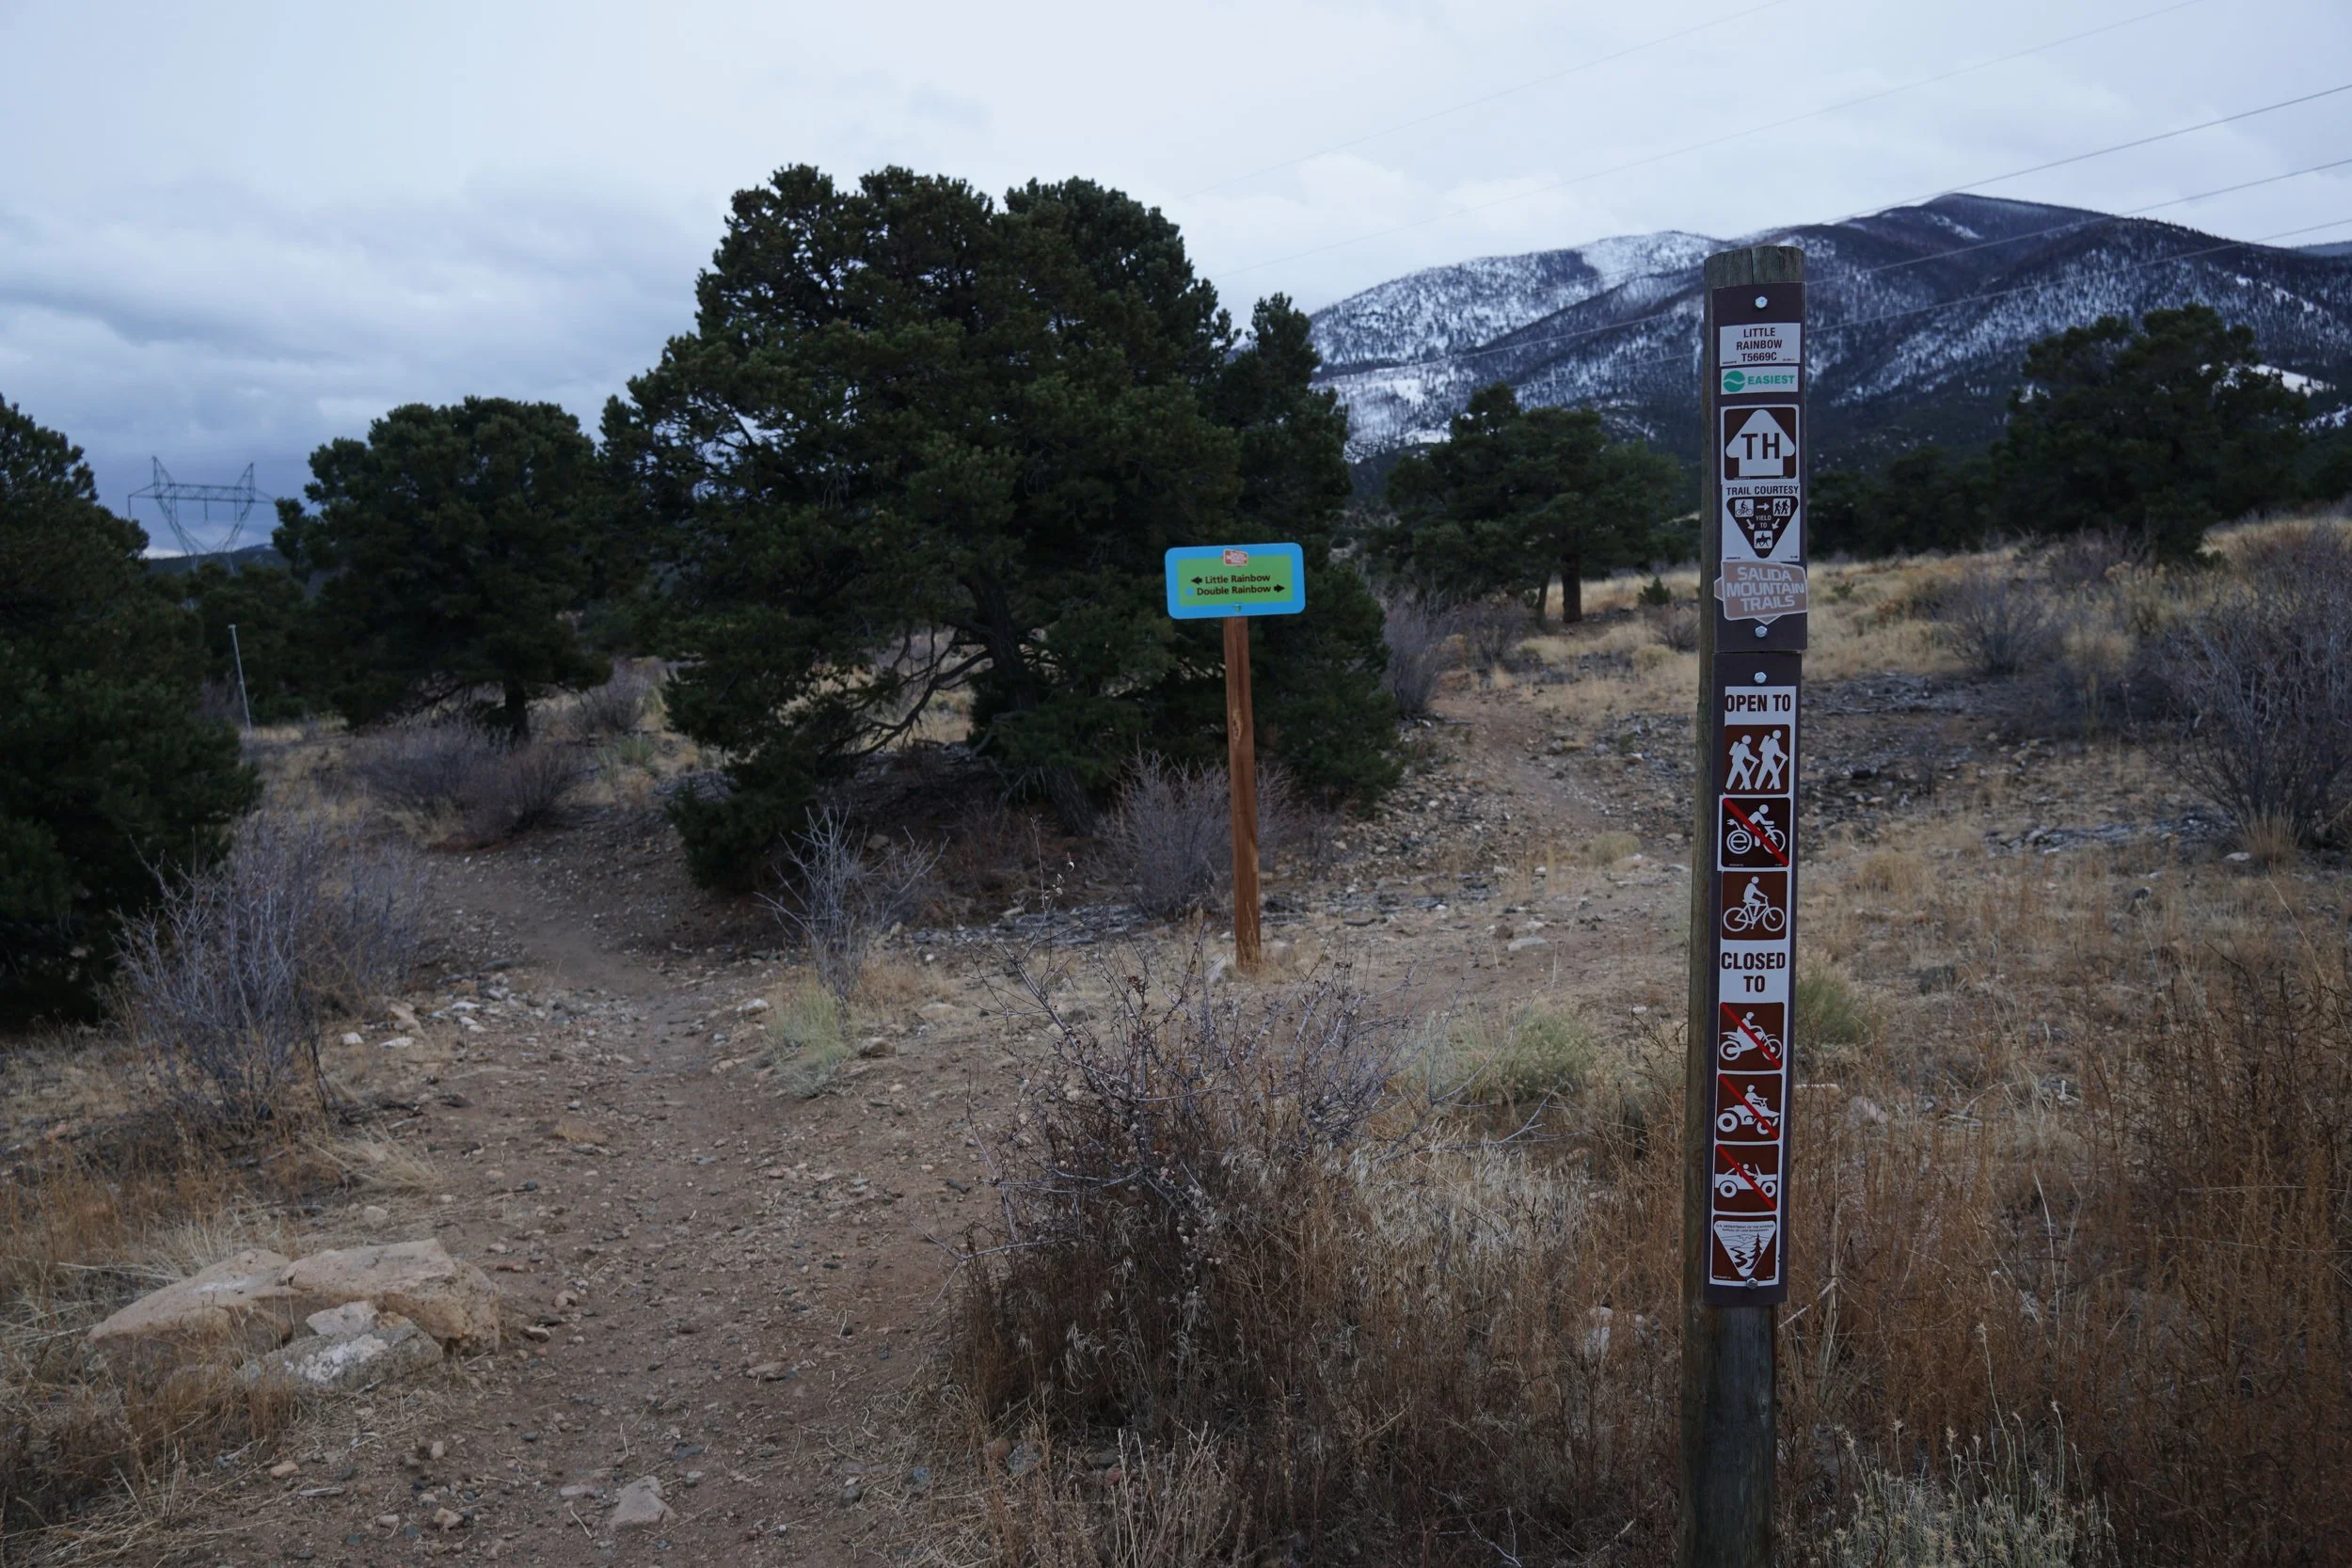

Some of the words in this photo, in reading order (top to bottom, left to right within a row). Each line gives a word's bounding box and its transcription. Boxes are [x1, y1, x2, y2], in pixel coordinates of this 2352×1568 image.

[1743, 327, 1776, 338] LITTLE
[1736, 340, 1783, 351] RAINBOW
[1741, 352, 1777, 362] T5669C
[1747, 375, 1795, 385] EASIEST
[1740, 433, 1780, 460] TH
[1726, 487, 1751, 496] TRAIL
[1755, 485, 1799, 496] COURTESY
[1205, 576, 1229, 584] Little
[1231, 574, 1271, 582] Rainbow
[1737, 566, 1792, 581] SALIDA
[1197, 586, 1230, 595] Double
[1232, 584, 1271, 594] Rainbow
[1726, 581, 1805, 597] MOUNTAIN
[1740, 594, 1796, 612] TRAILS
[1724, 694, 1768, 712] OPEN
[1772, 694, 1791, 712] TO
[1721, 952, 1786, 970] CLOSED
[1743, 975, 1765, 992] TO
